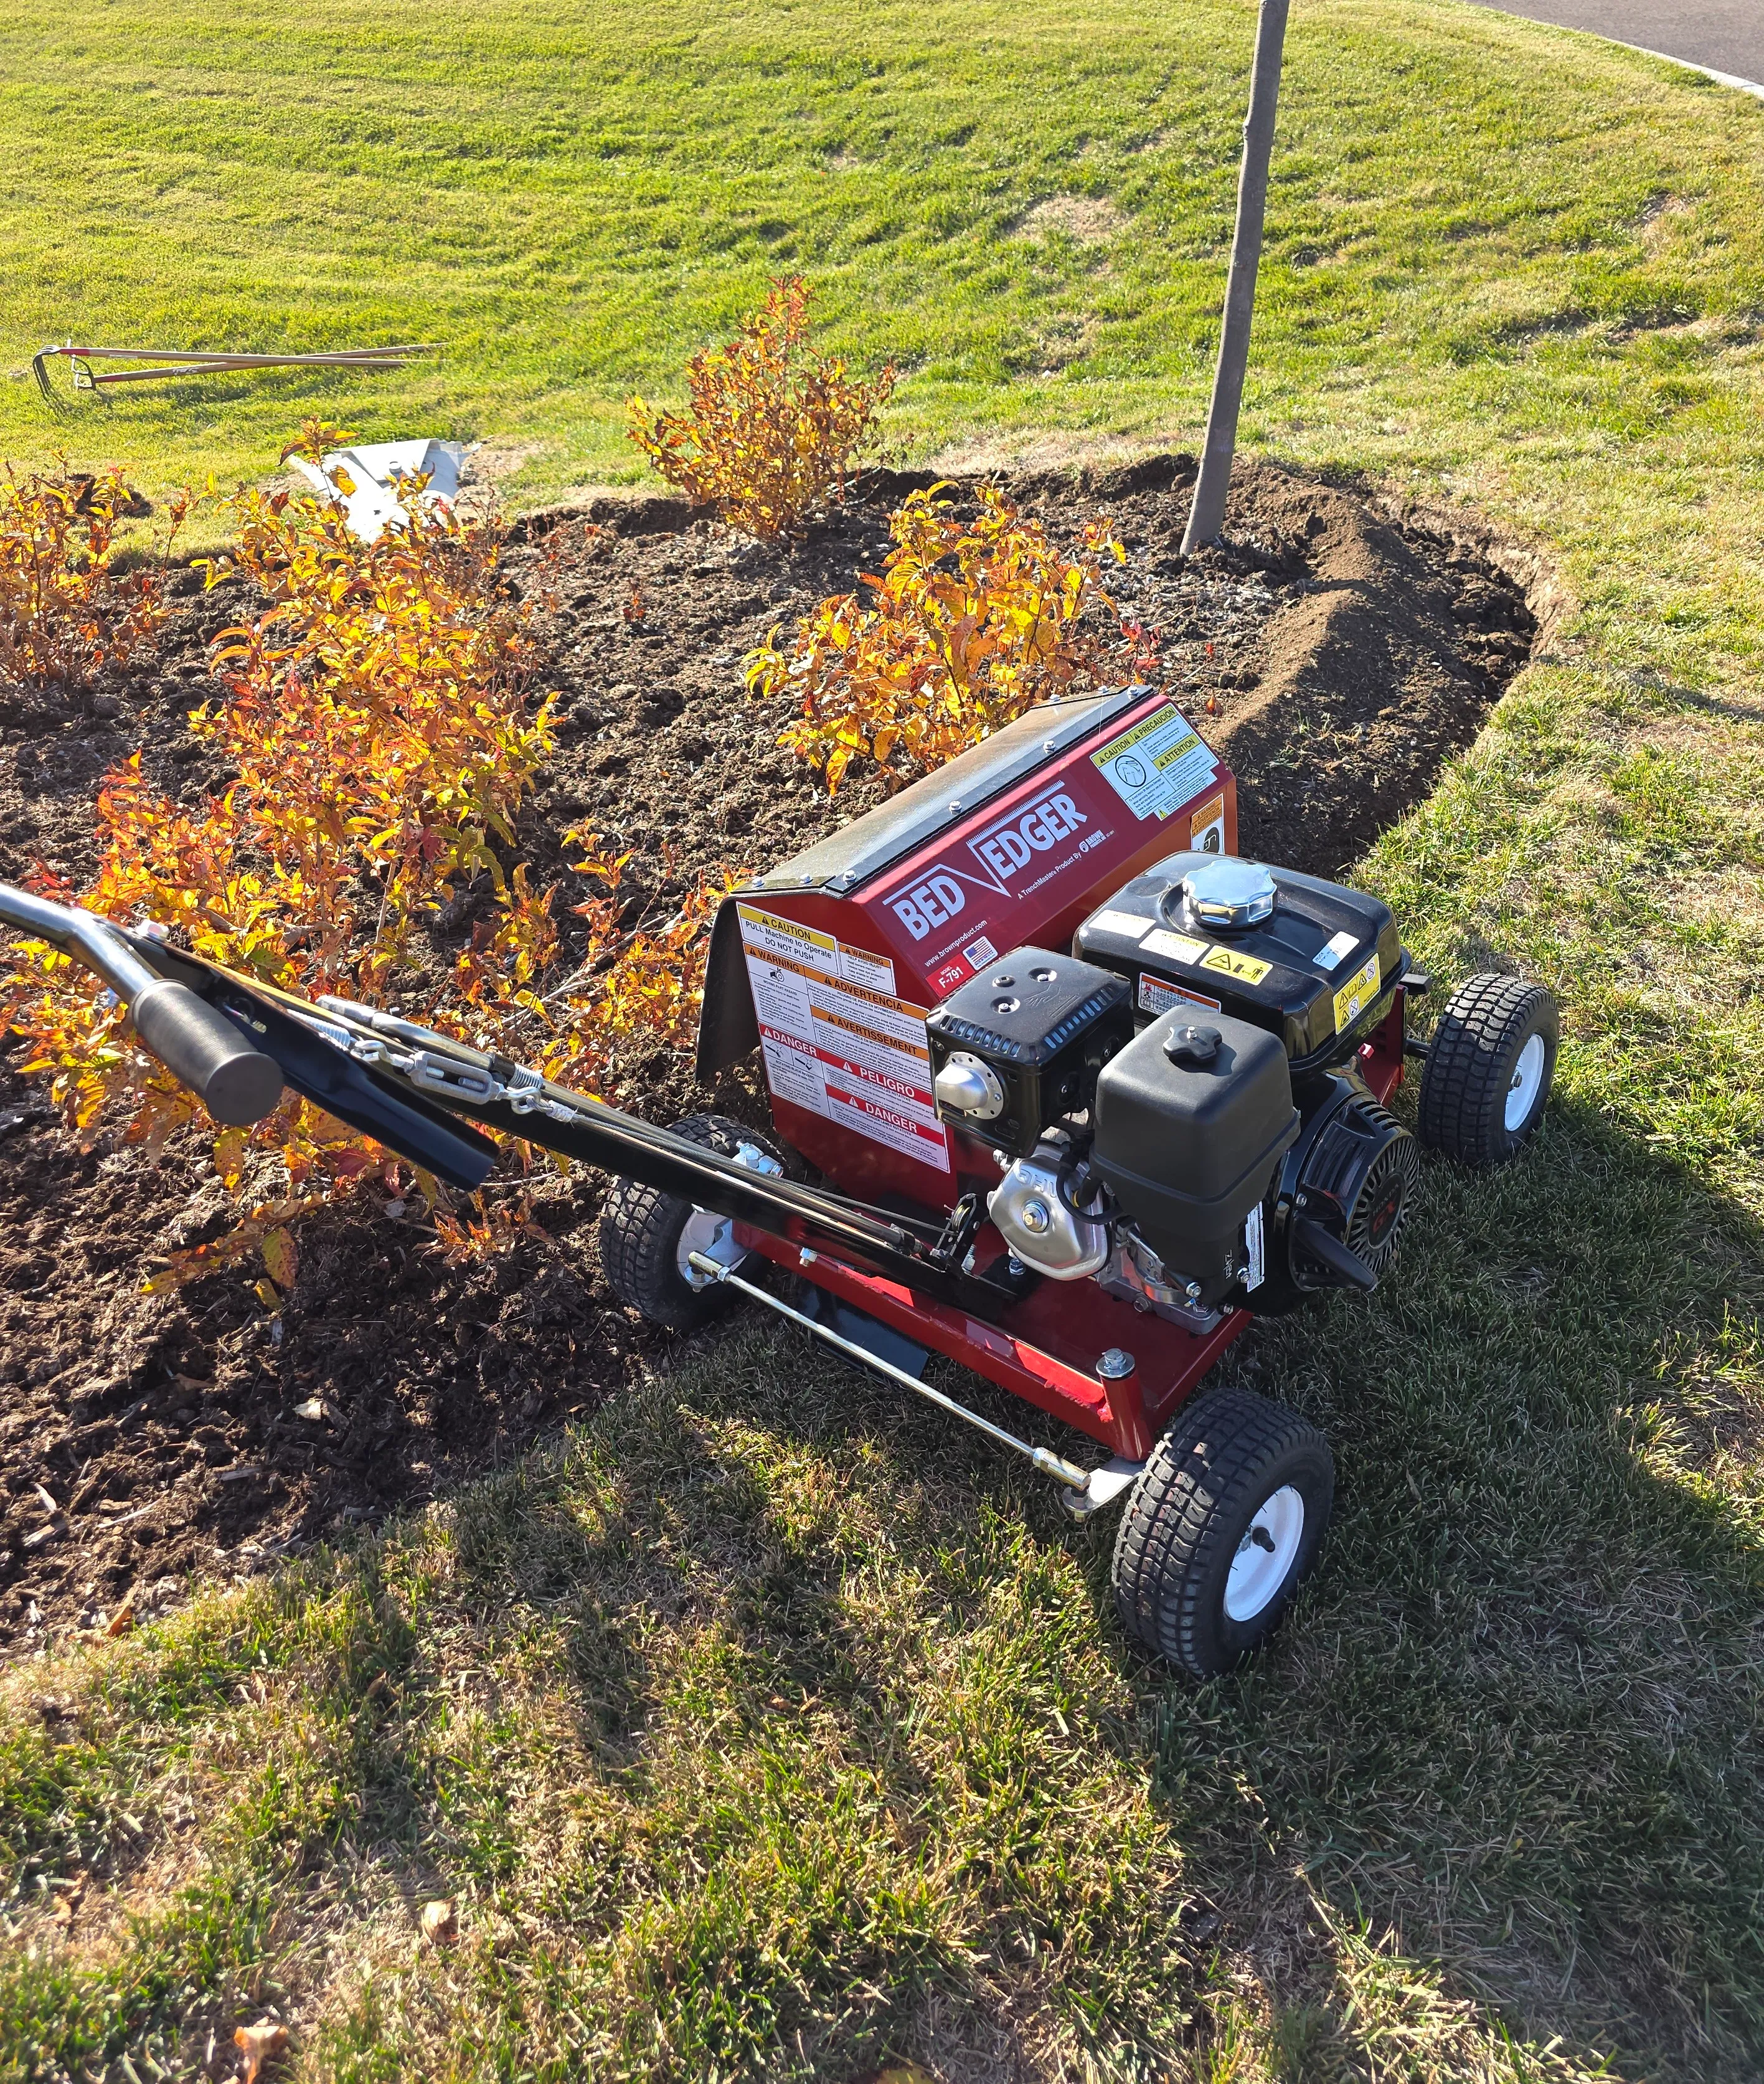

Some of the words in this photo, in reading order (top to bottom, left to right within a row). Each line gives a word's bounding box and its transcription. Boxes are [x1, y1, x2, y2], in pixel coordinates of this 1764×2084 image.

[1104, 739, 1131, 759] CAUTION
[1164, 738, 1196, 763] ATTENTION
[1085, 830, 1104, 845] BROWN
[892, 875, 965, 941] BED
[979, 794, 1088, 879] EDGER
[1054, 856, 1075, 872] Product
[1072, 851, 1082, 860] By
[745, 921, 764, 934] PULL
[765, 927, 794, 944] Machine
[795, 939, 802, 947] to
[804, 942, 832, 959] Operate
[771, 919, 811, 941] CAUTION
[765, 937, 776, 947] DO
[777, 941, 793, 954] NOT
[794, 947, 814, 962] PUSH
[925, 920, 988, 967] www.brownproduct.com
[758, 950, 800, 973] WARNING
[852, 949, 884, 965] WARNING
[938, 966, 963, 988] F-791
[940, 966, 953, 975] MODEL
[835, 980, 903, 1011] ADVERTENCIA
[773, 1031, 817, 1057] DANGER
[837, 1018, 917, 1055] AVERTISSEMENT
[859, 1067, 915, 1097] PELIGRO
[865, 1103, 917, 1134] DANGER
